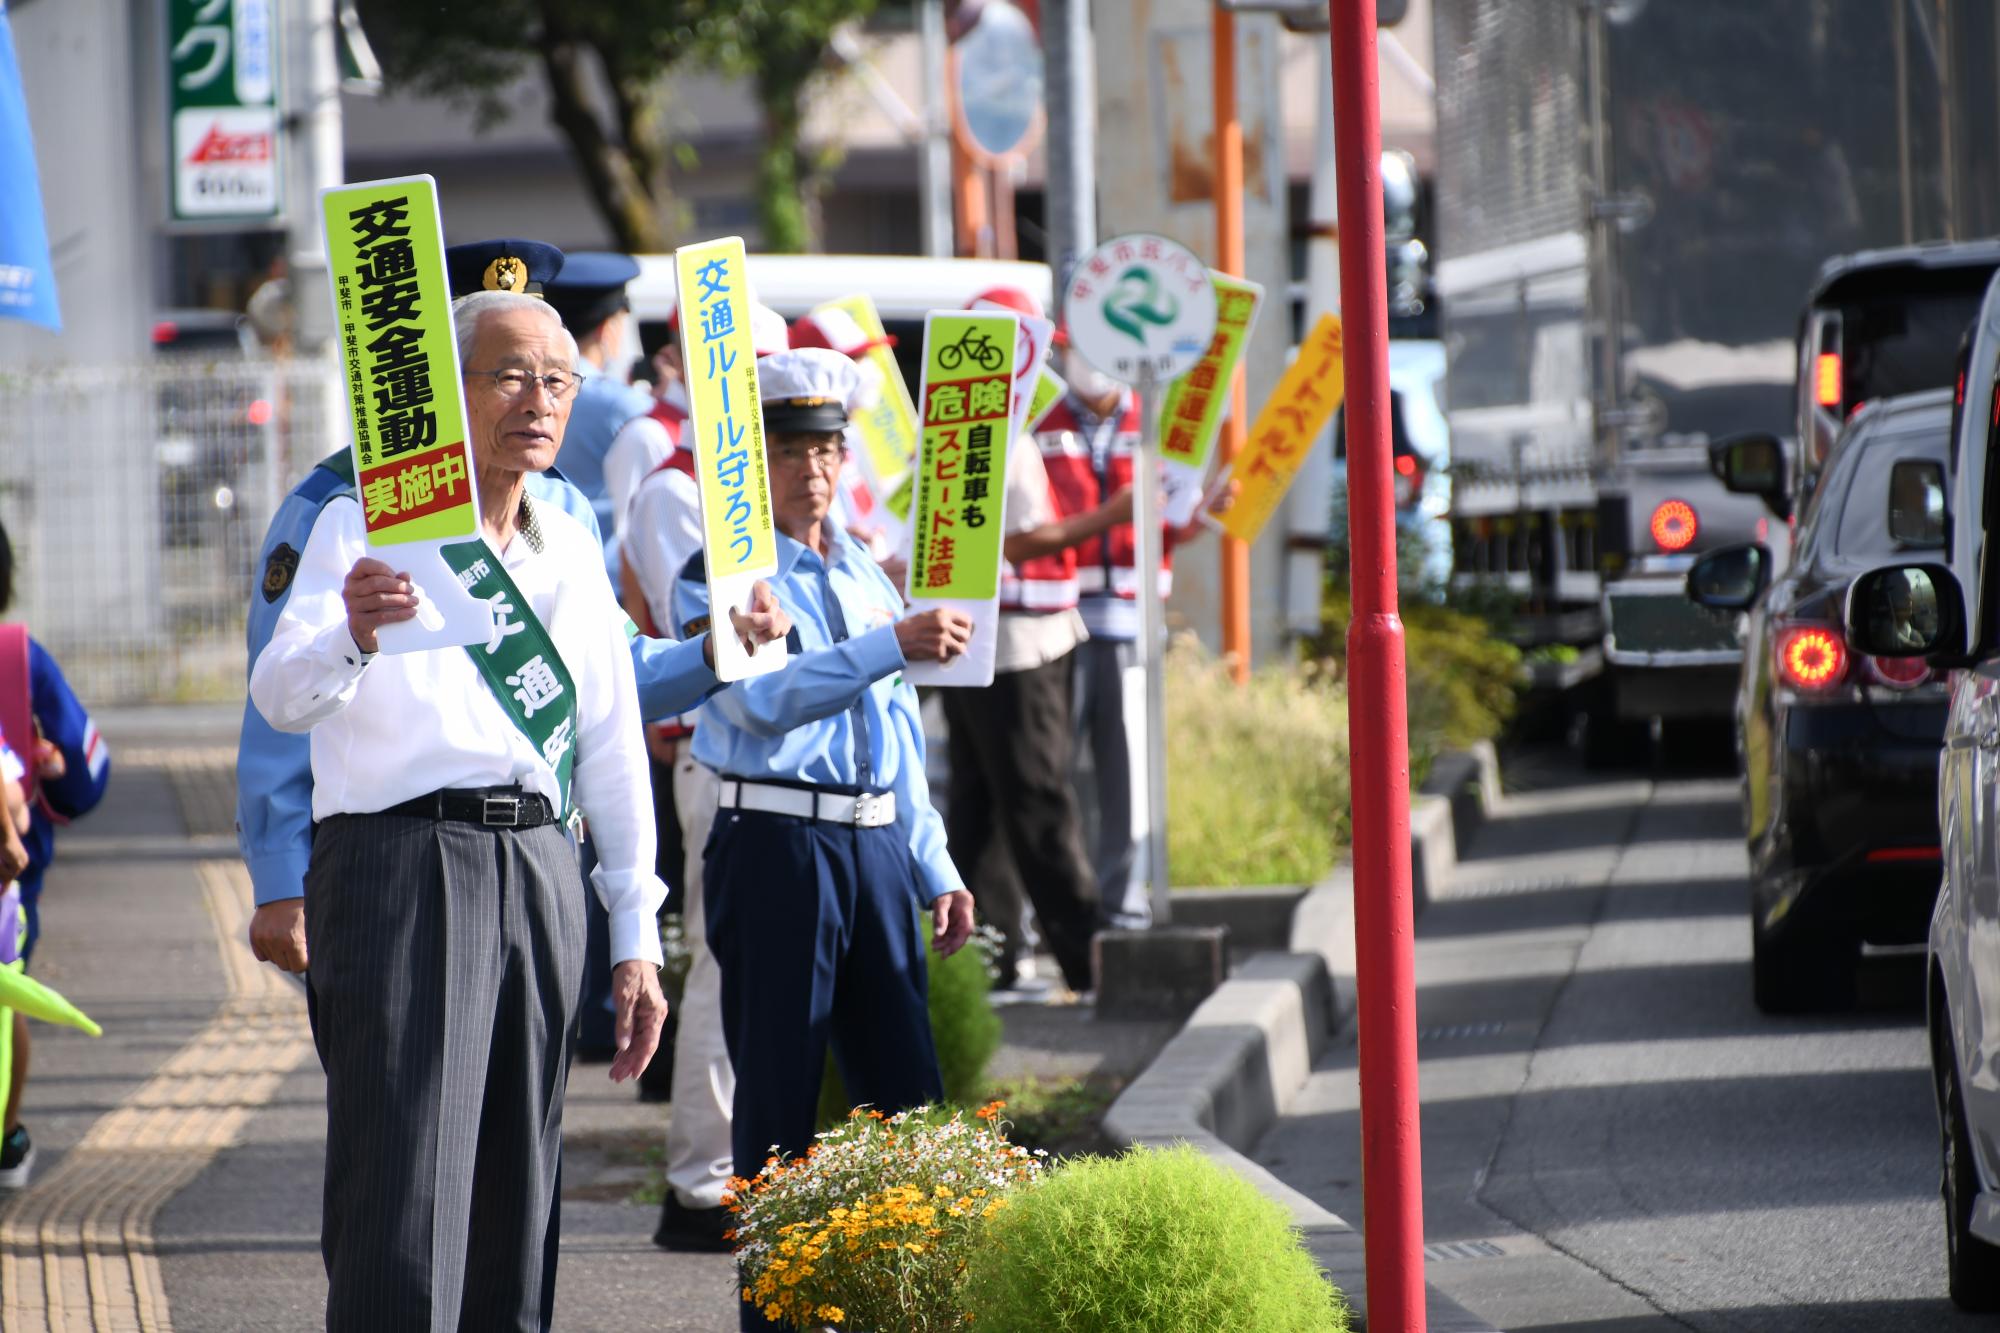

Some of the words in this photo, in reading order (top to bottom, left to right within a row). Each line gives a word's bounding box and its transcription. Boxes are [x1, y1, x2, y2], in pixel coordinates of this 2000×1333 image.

[349, 195, 437, 459] 交通安全運動
[696, 257, 754, 564] 交通ルール守ろう
[928, 378, 1008, 422] 危険
[362, 451, 467, 525] 実施中
[926, 429, 962, 589] スピード注意
[961, 422, 993, 529] 自転車も
